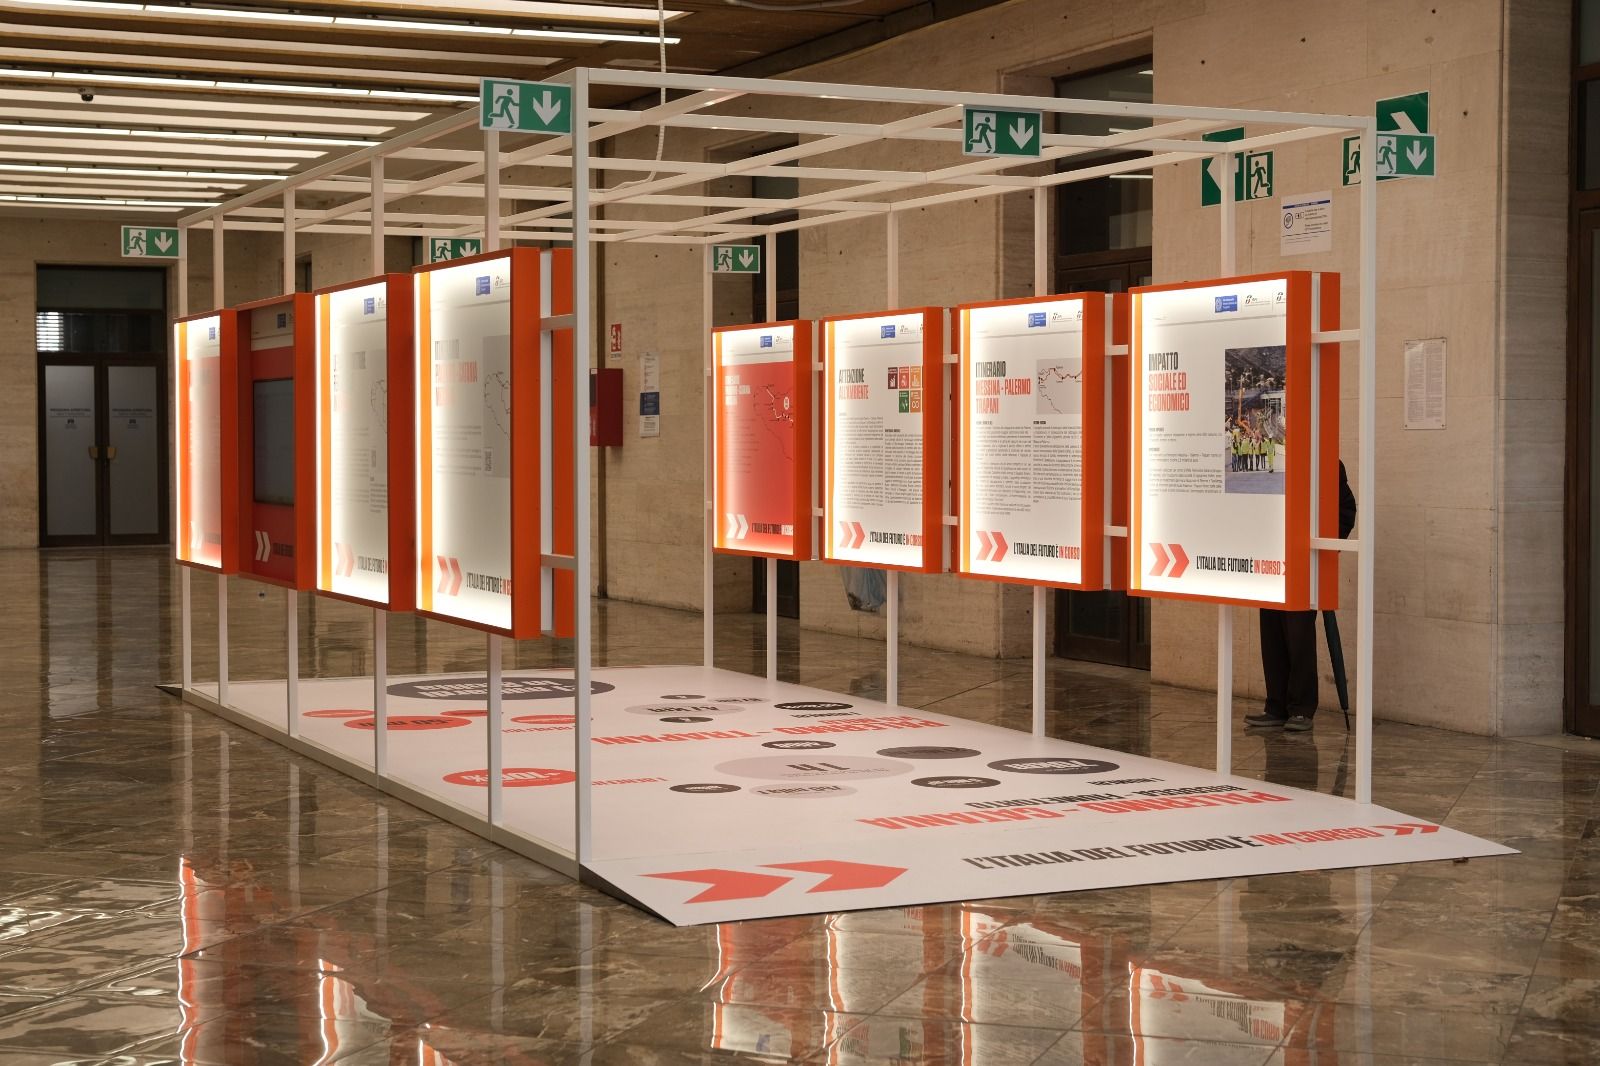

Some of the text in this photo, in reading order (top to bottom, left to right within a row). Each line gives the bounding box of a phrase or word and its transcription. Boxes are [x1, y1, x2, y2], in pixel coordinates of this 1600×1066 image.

[976, 361, 1006, 378] ITINERARIO
[1148, 352, 1178, 371] IMPATTO
[1004, 378, 1031, 395] PALERMO
[1149, 372, 1186, 392] SOCIALE ED
[1149, 392, 1190, 412] ECONOMICO
[1196, 556, 1216, 570] L'ITALIA
[1217, 557, 1227, 571] DEL
[1228, 558, 1248, 573] FUTURO
[1261, 560, 1280, 575] CORSO
[772, 720, 948, 735] PALERMO
[592, 730, 755, 745] TRAPANI
[963, 793, 1124, 809] FIUMETORTO
[1076, 791, 1292, 814] PALERMO
[856, 807, 1065, 830] CATANIA
[962, 827, 1384, 870] L'ITALIA DEL FUTURO È IN CORSO
